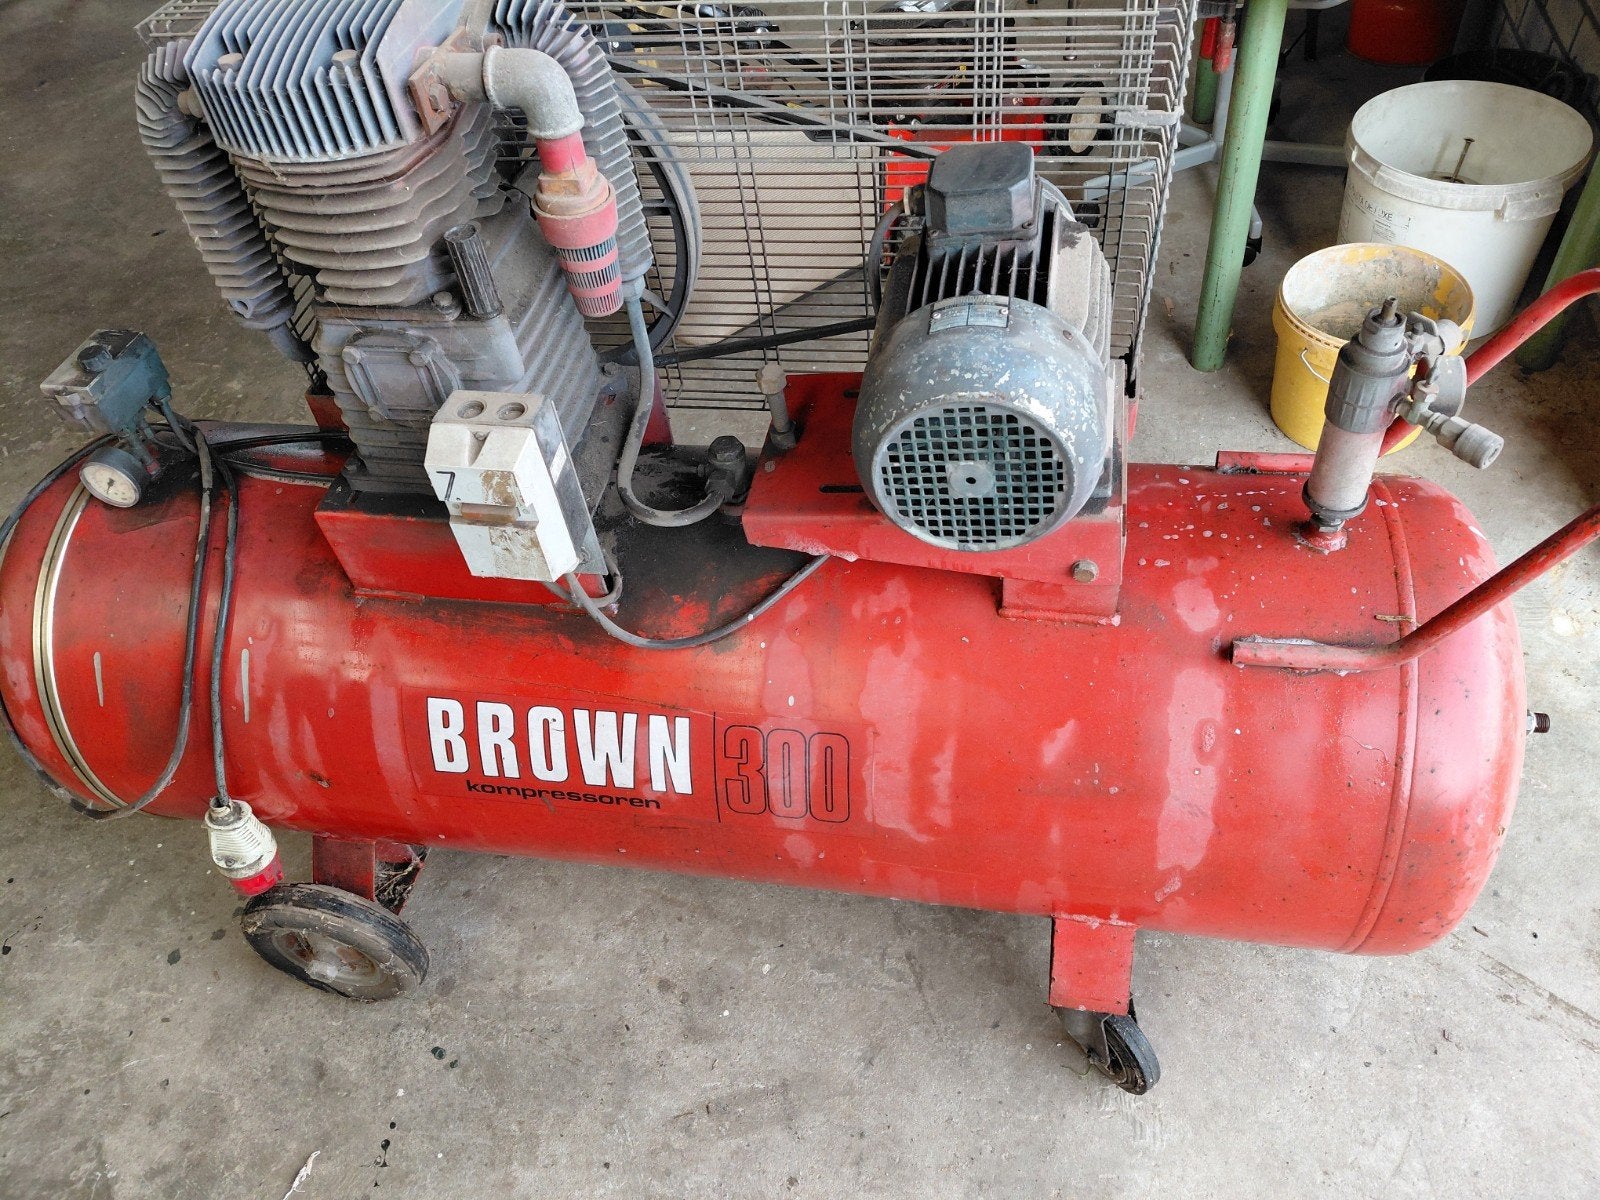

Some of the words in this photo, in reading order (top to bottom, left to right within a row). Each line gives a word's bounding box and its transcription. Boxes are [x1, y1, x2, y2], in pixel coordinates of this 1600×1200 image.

[427, 697, 693, 794] BROWN
[724, 725, 850, 823] 300
[466, 779, 661, 809] kompressoren
